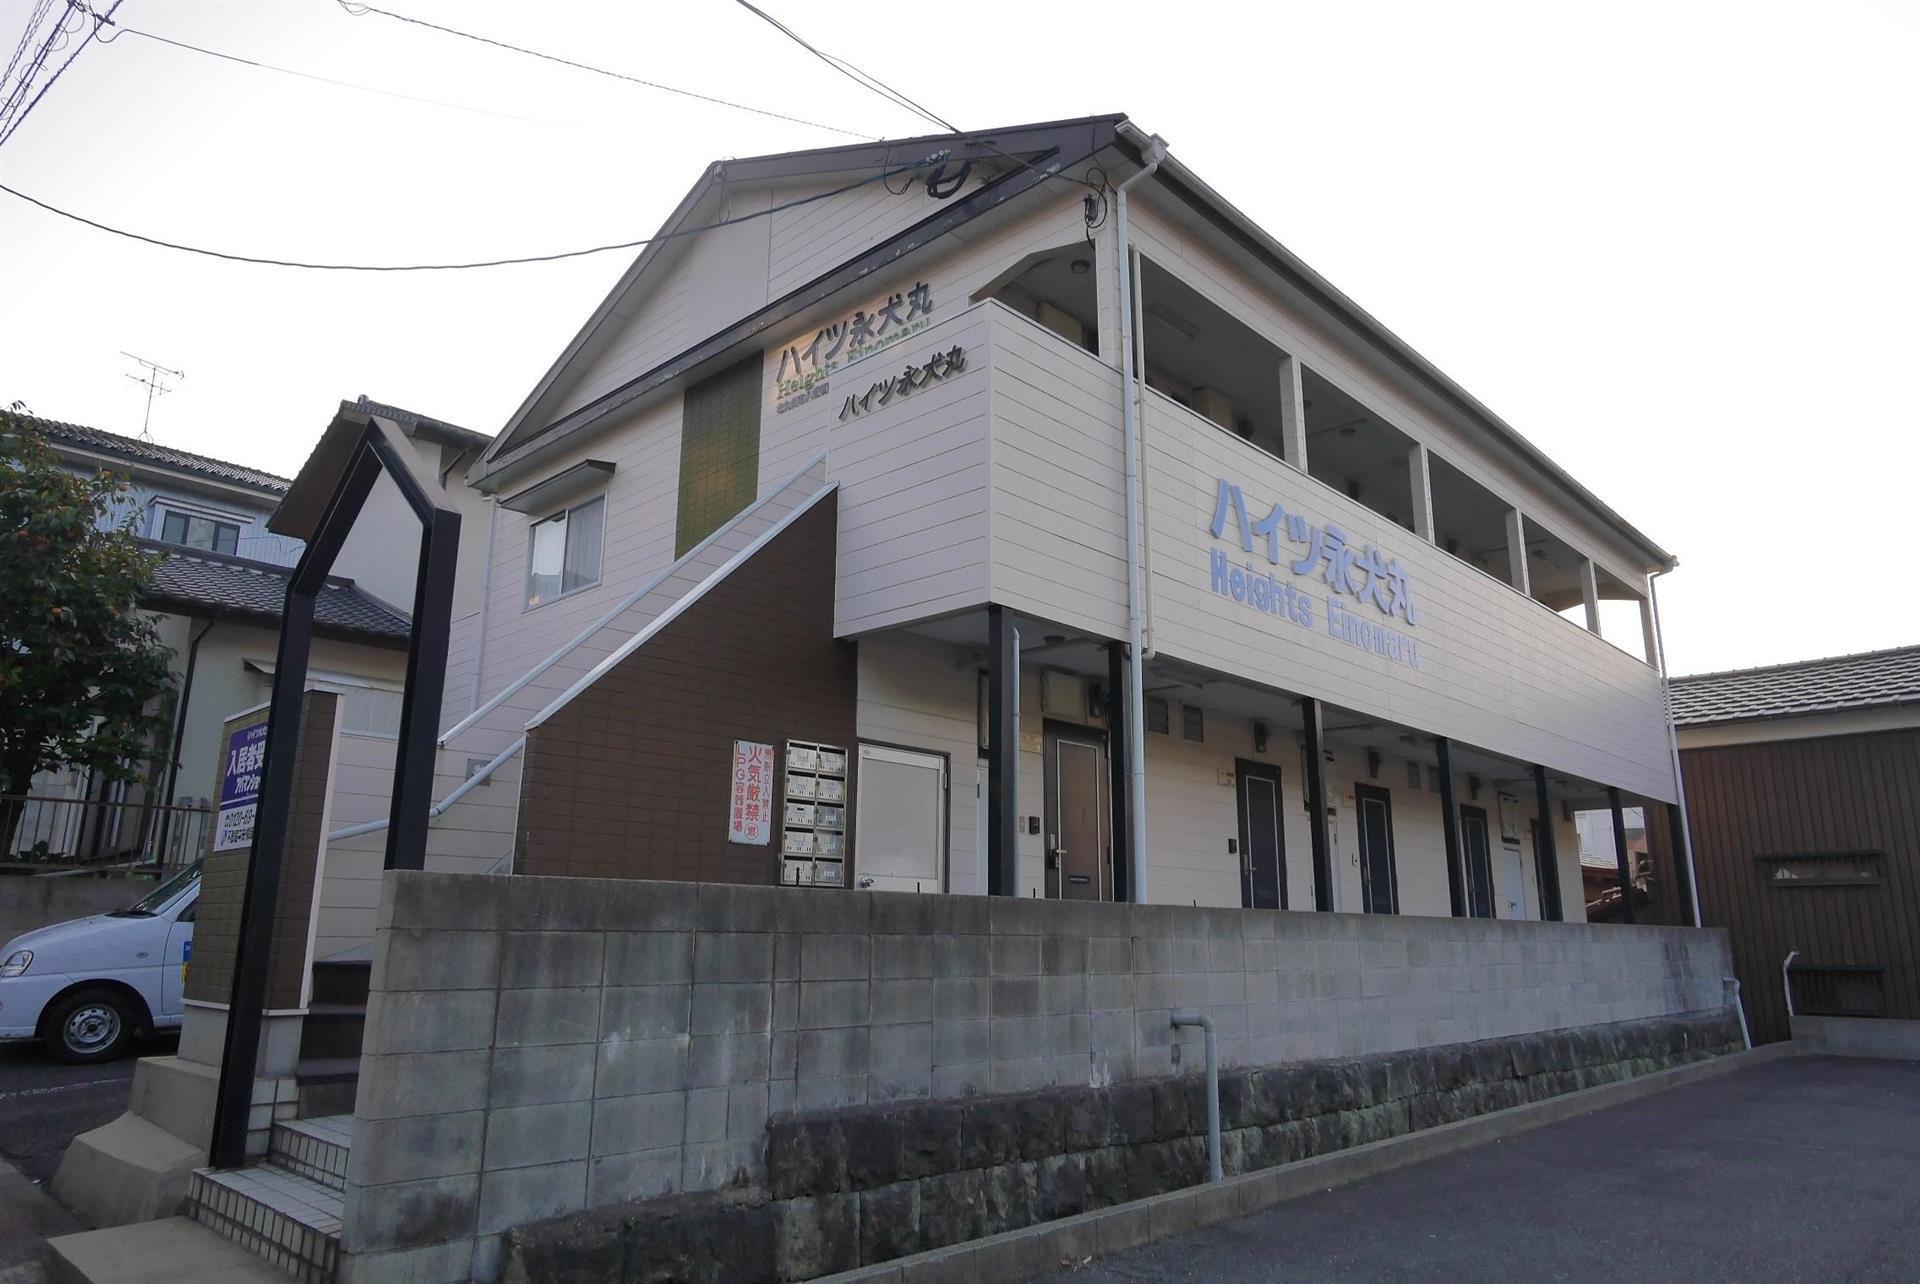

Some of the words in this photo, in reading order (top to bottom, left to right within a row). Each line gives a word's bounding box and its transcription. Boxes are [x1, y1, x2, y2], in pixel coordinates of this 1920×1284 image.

[776, 281, 932, 382] ハイツ永犬丸
[838, 345, 967, 422] ハイツ永犬丸
[1210, 478, 1417, 627] ハイツ永犬丸
[1210, 546, 1314, 629] Heights
[745, 745, 762, 821] 火気厳禁
